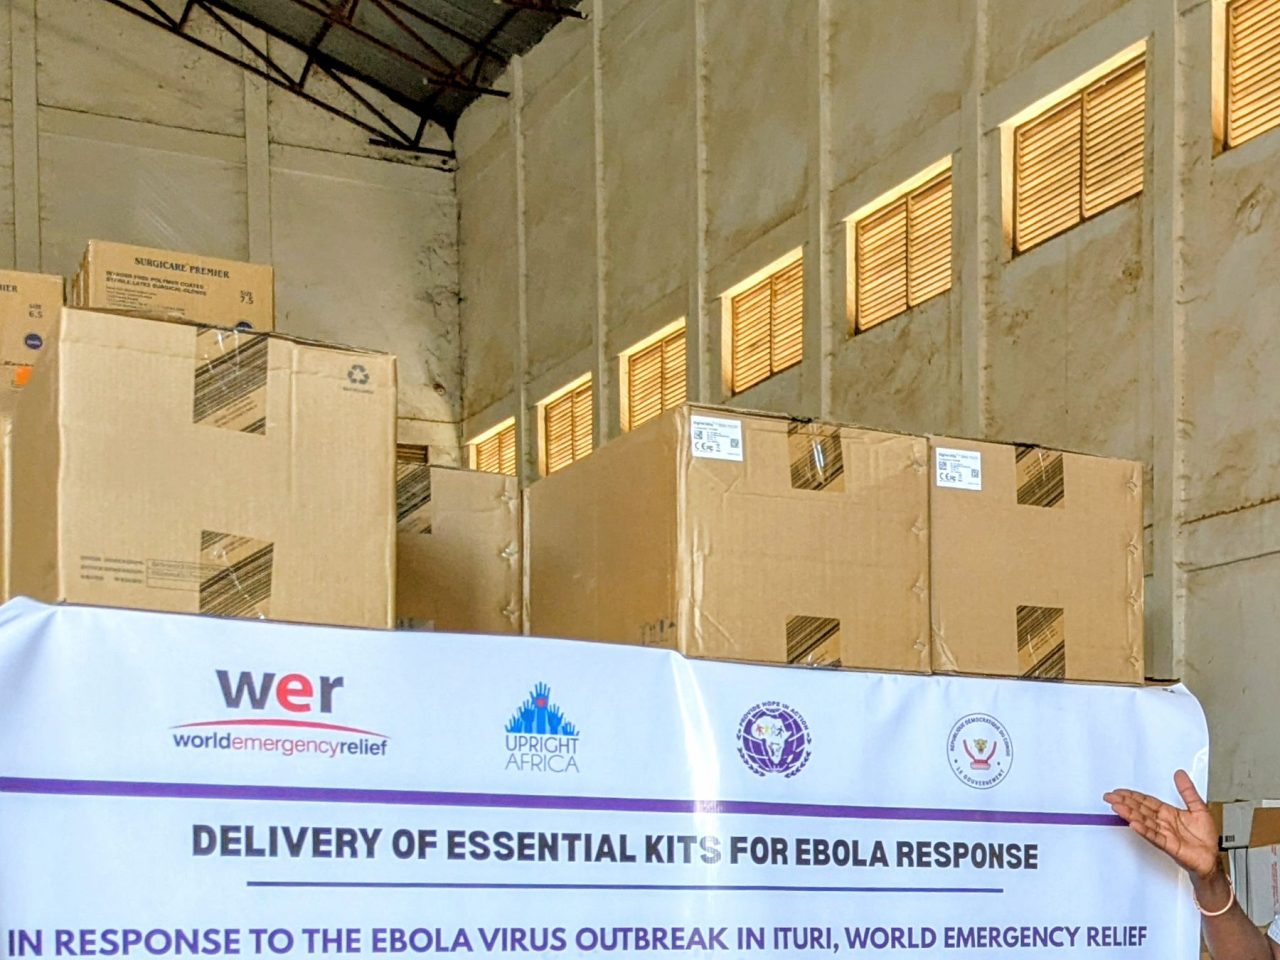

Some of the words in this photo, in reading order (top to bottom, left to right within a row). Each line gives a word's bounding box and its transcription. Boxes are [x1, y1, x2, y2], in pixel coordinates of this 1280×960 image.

[134, 257, 187, 272] SURGICARE
[189, 266, 230, 279] PREMIER
[215, 668, 345, 715] wer
[172, 730, 388, 758] worldemergencyrelief
[504, 734, 580, 756] UPRIGHT
[504, 753, 580, 774] AFRICA
[192, 824, 383, 859] DELIVERY
[391, 828, 438, 860] OF
[446, 829, 637, 863] ESSENTIAL
[644, 834, 721, 864] KITS
[730, 836, 789, 866] FOR
[795, 837, 890, 867] EBOLA
[895, 840, 1038, 867] RESPONSE
[8, 929, 43, 957] IN
[54, 928, 241, 957] RESPONSE
[248, 927, 294, 955] TO
[301, 927, 361, 954] THE
[371, 927, 474, 953] EBOLA
[477, 926, 567, 952] VIRUS
[575, 926, 729, 952] OUTBREAK
[737, 926, 765, 951] IN
[773, 926, 840, 954] ITURI,
[843, 926, 937, 950] WORLD
[943, 925, 1081, 949] EMERGENCY
[1086, 925, 1148, 947] RELIEF
